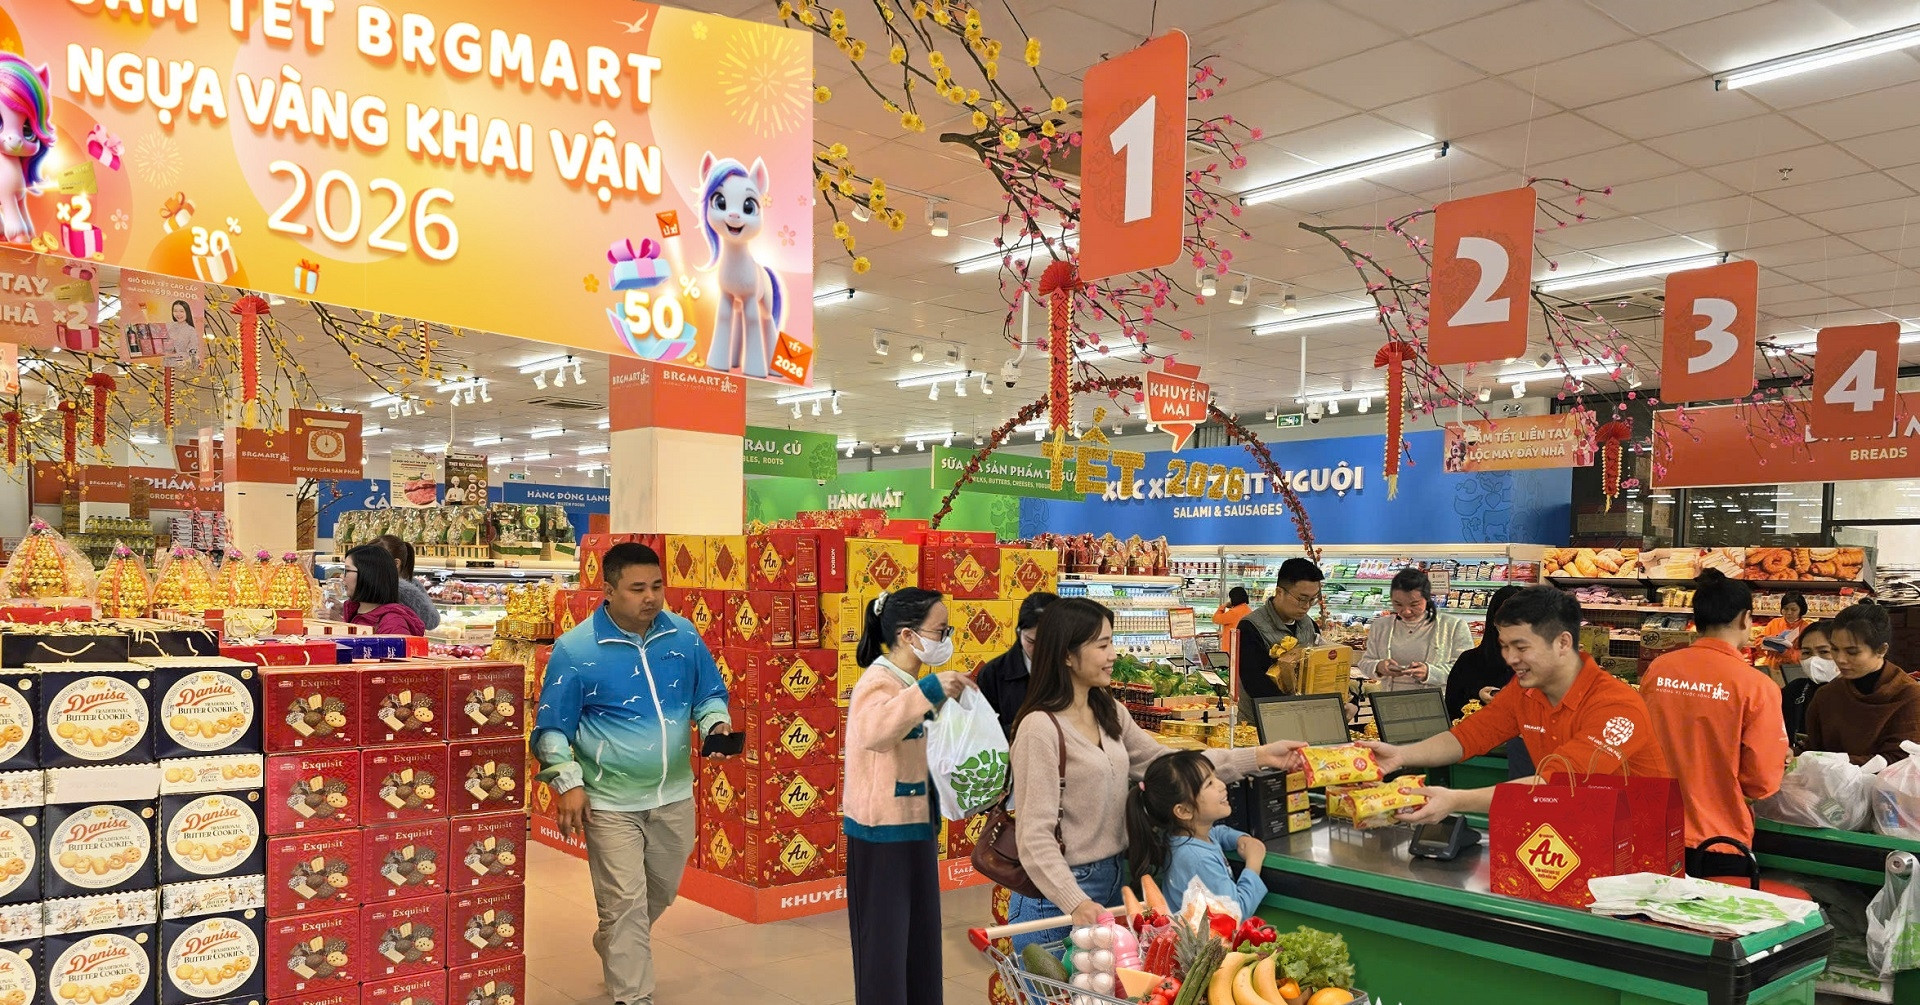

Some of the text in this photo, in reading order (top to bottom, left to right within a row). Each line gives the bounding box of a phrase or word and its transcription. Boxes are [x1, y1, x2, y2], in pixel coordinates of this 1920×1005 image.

[357, 5, 662, 104] BRGMART
[67, 43, 662, 202] NGỰA VÀNG KHAI VẬN
[1109, 94, 1156, 224] 1
[267, 159, 459, 262] 2026
[0, 272, 49, 295] TAY
[1447, 236, 1511, 327] 2
[0, 302, 40, 325] HÀ
[1687, 298, 1738, 374] 3
[774, 354, 804, 379] 2026
[612, 371, 641, 386] BRGMART
[662, 370, 720, 386] BRGMART
[1823, 349, 1885, 412] 4
[1149, 381, 1207, 403] KHUYẾN
[1161, 400, 1190, 420] MẠI
[1495, 427, 1517, 443] TẾT
[1519, 425, 1546, 442] LIỀN
[1548, 428, 1571, 440] TAY
[241, 451, 280, 459] BRGMART
[744, 438, 802, 456] RAU, CỦ
[1041, 406, 1146, 498] TẾT
[1166, 459, 1247, 502] 2026
[1469, 448, 1490, 463] LỘC
[1492, 448, 1515, 460] MAY
[1850, 446, 1908, 460] BREADS
[762, 457, 784, 465] ROOTS
[941, 457, 964, 471] SỮA
[1010, 463, 1044, 480] PHẨM
[527, 489, 555, 500] HÀNG
[827, 488, 868, 511] HÀNG
[1173, 502, 1283, 519] SALAMI & SAUSAGES
[764, 552, 778, 569] An
[875, 559, 895, 577] An
[960, 562, 979, 580] An
[1020, 564, 1039, 580] An
[740, 608, 754, 626] An
[974, 616, 992, 632] An
[301, 679, 341, 689] Exquisit
[392, 675, 431, 687] Exquisit
[476, 672, 511, 682] Exquisit
[788, 668, 811, 687] An
[1656, 676, 1713, 693] BRGMART
[63, 688, 129, 714] Danisa
[175, 682, 236, 707] Danisa
[178, 705, 239, 715] BUTTER COOKIES
[788, 727, 811, 745] An
[302, 759, 344, 771] Exquisit
[393, 752, 431, 765] Exquisit
[715, 780, 729, 799] An
[788, 785, 811, 804] An
[181, 806, 241, 832] Danisa
[477, 821, 513, 833] Exquisit
[65, 816, 131, 843] Danisa
[183, 829, 244, 839] BUTTER COOKIES
[395, 828, 434, 841] Exquisit
[68, 841, 134, 851] BUTTER COOKIES
[303, 839, 344, 852] Exquisit
[787, 843, 810, 863] An
[1528, 838, 1568, 869] An
[953, 866, 974, 875] SALE
[476, 893, 511, 905] Exquisit
[392, 905, 430, 919] Exquisit
[302, 918, 343, 933] Exquisit
[181, 928, 241, 957] Danisa
[65, 945, 130, 975] Danisa
[213, 950, 244, 960] COOKIES
[100, 968, 133, 978] COOKIES
[477, 964, 512, 978] Exquisit
[393, 980, 431, 994] Exquisit
